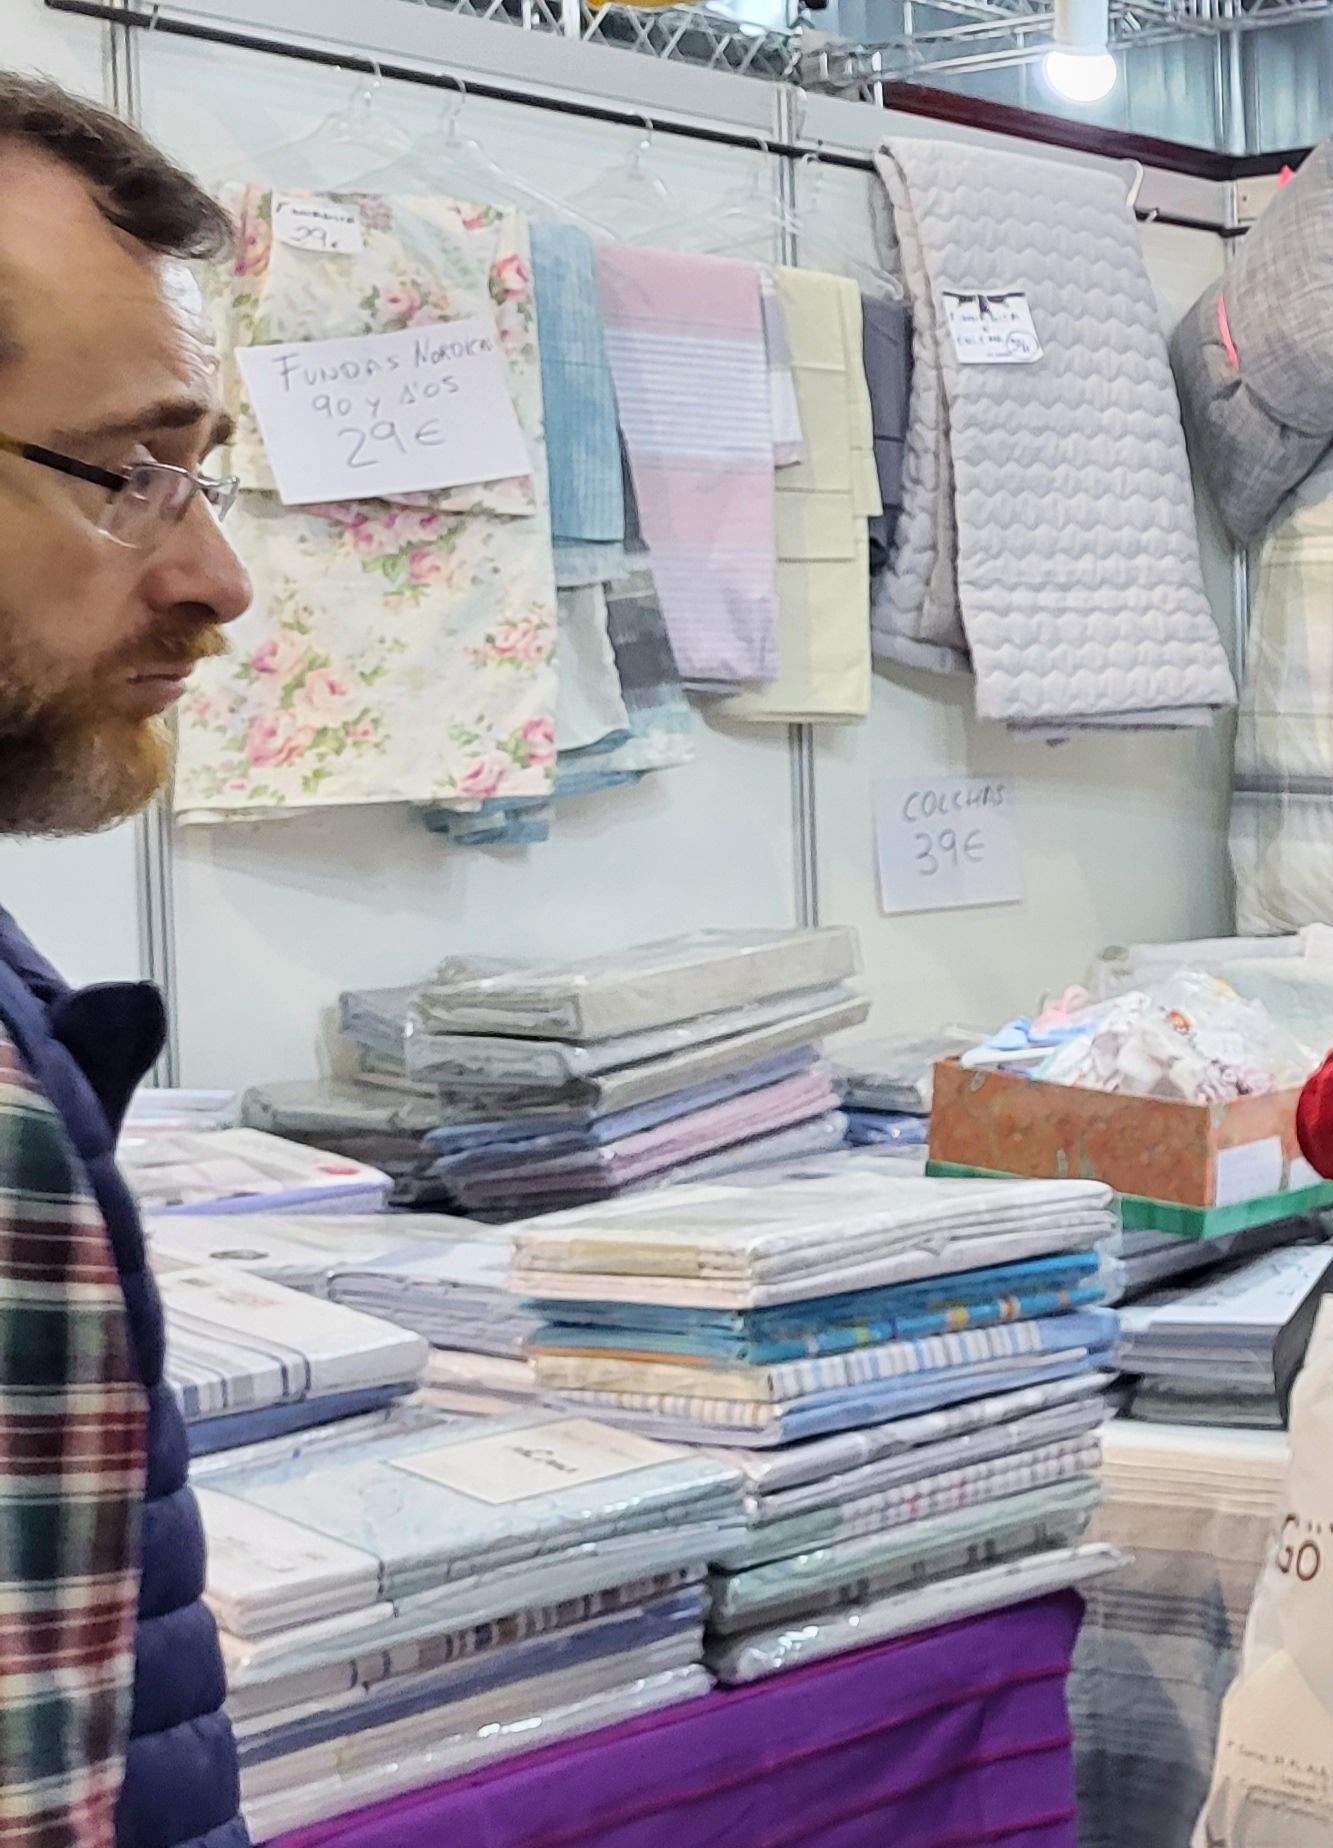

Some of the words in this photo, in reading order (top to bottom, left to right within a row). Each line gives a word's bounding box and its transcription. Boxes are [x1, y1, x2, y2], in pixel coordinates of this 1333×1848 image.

[272, 352, 400, 392] FUNDAS
[311, 394, 351, 418] 90
[337, 420, 447, 469] 29€
[914, 828, 987, 876] 39€
